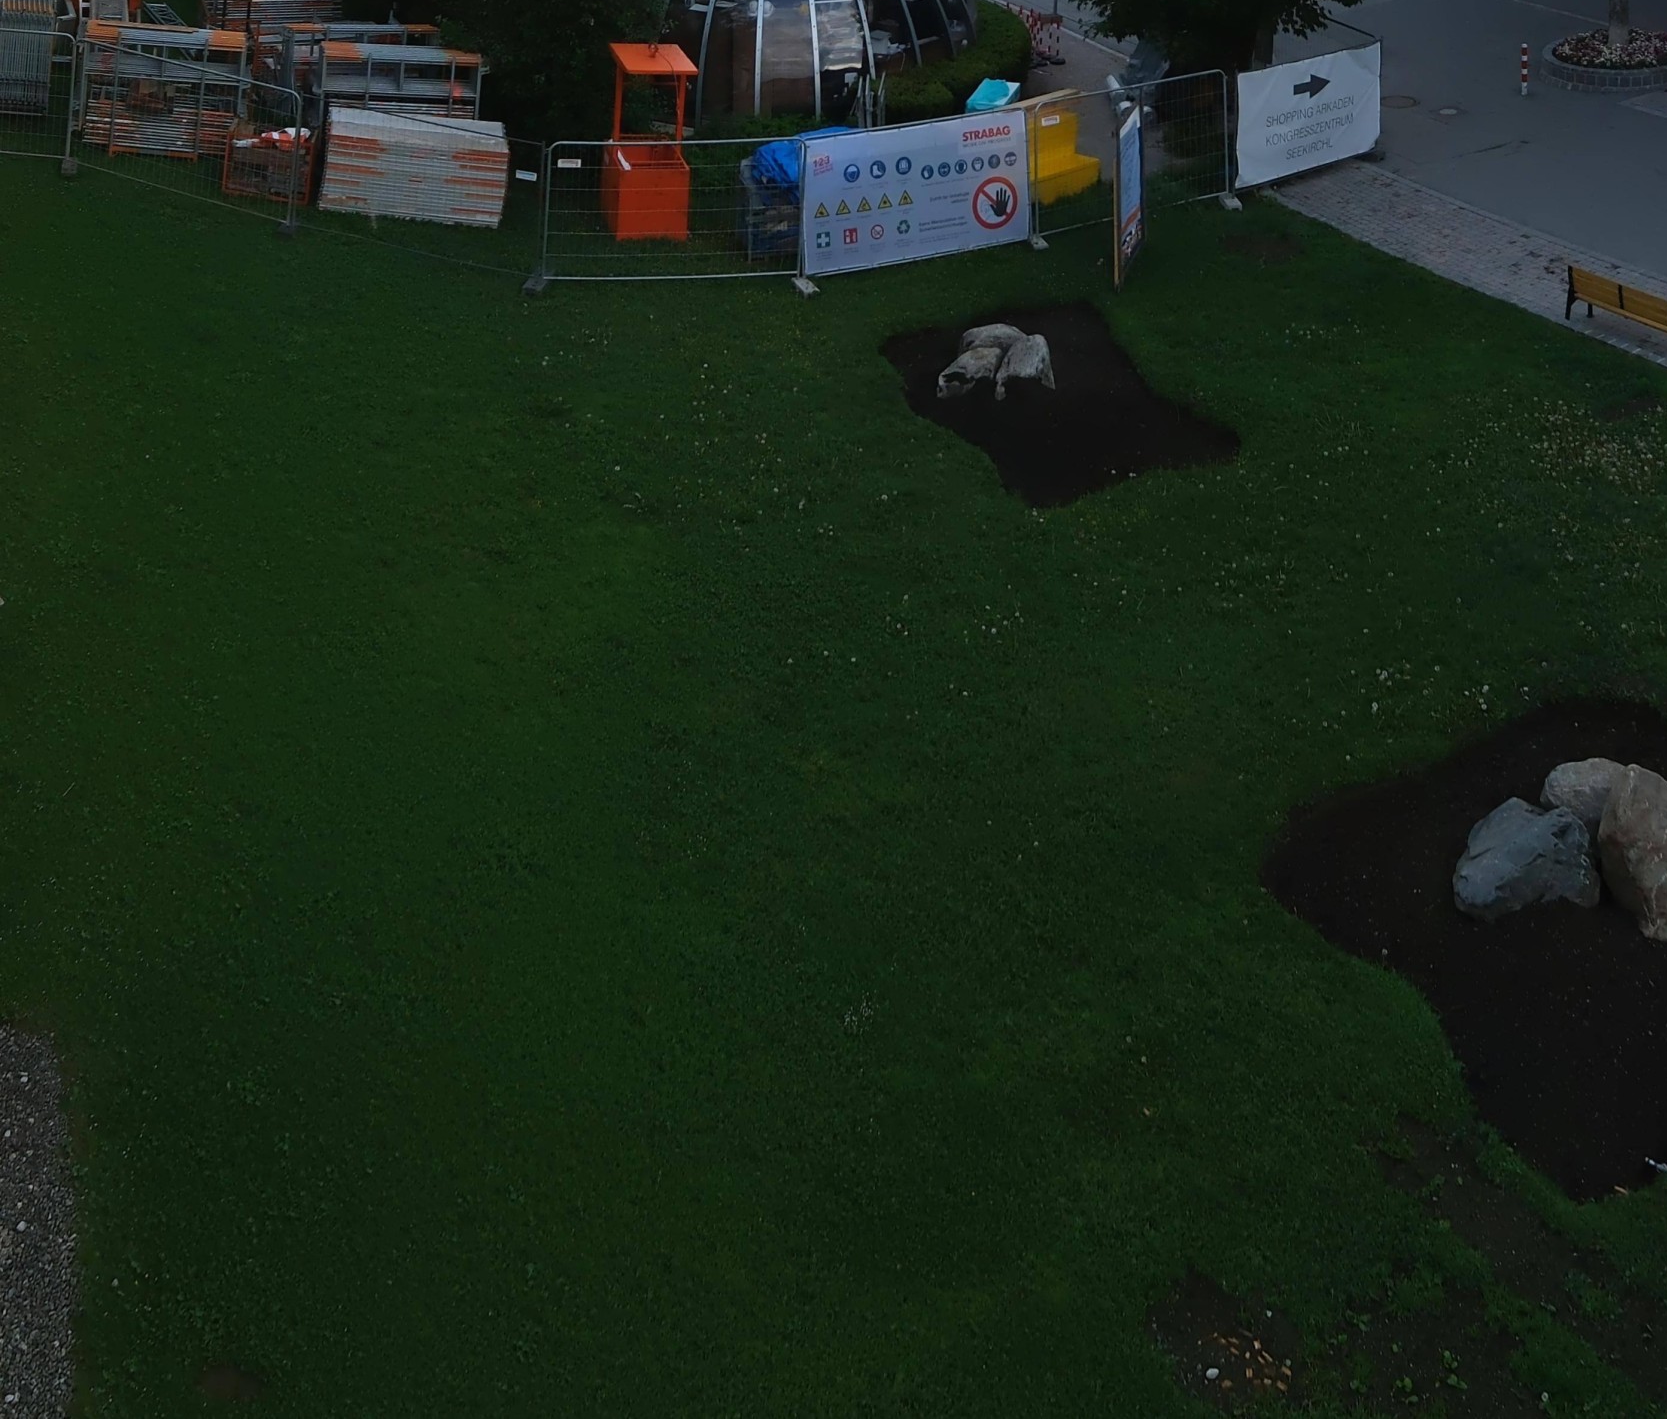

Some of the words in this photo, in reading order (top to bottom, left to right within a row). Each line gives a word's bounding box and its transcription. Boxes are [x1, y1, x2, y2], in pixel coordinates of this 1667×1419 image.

[1266, 106, 1314, 128] SHOPPING
[1316, 95, 1355, 115] ARKADEN
[962, 125, 1011, 142] STRABAG
[1265, 112, 1355, 147] KONGRESSZENTRUM
[1286, 138, 1334, 160] SEEKIRCHL
